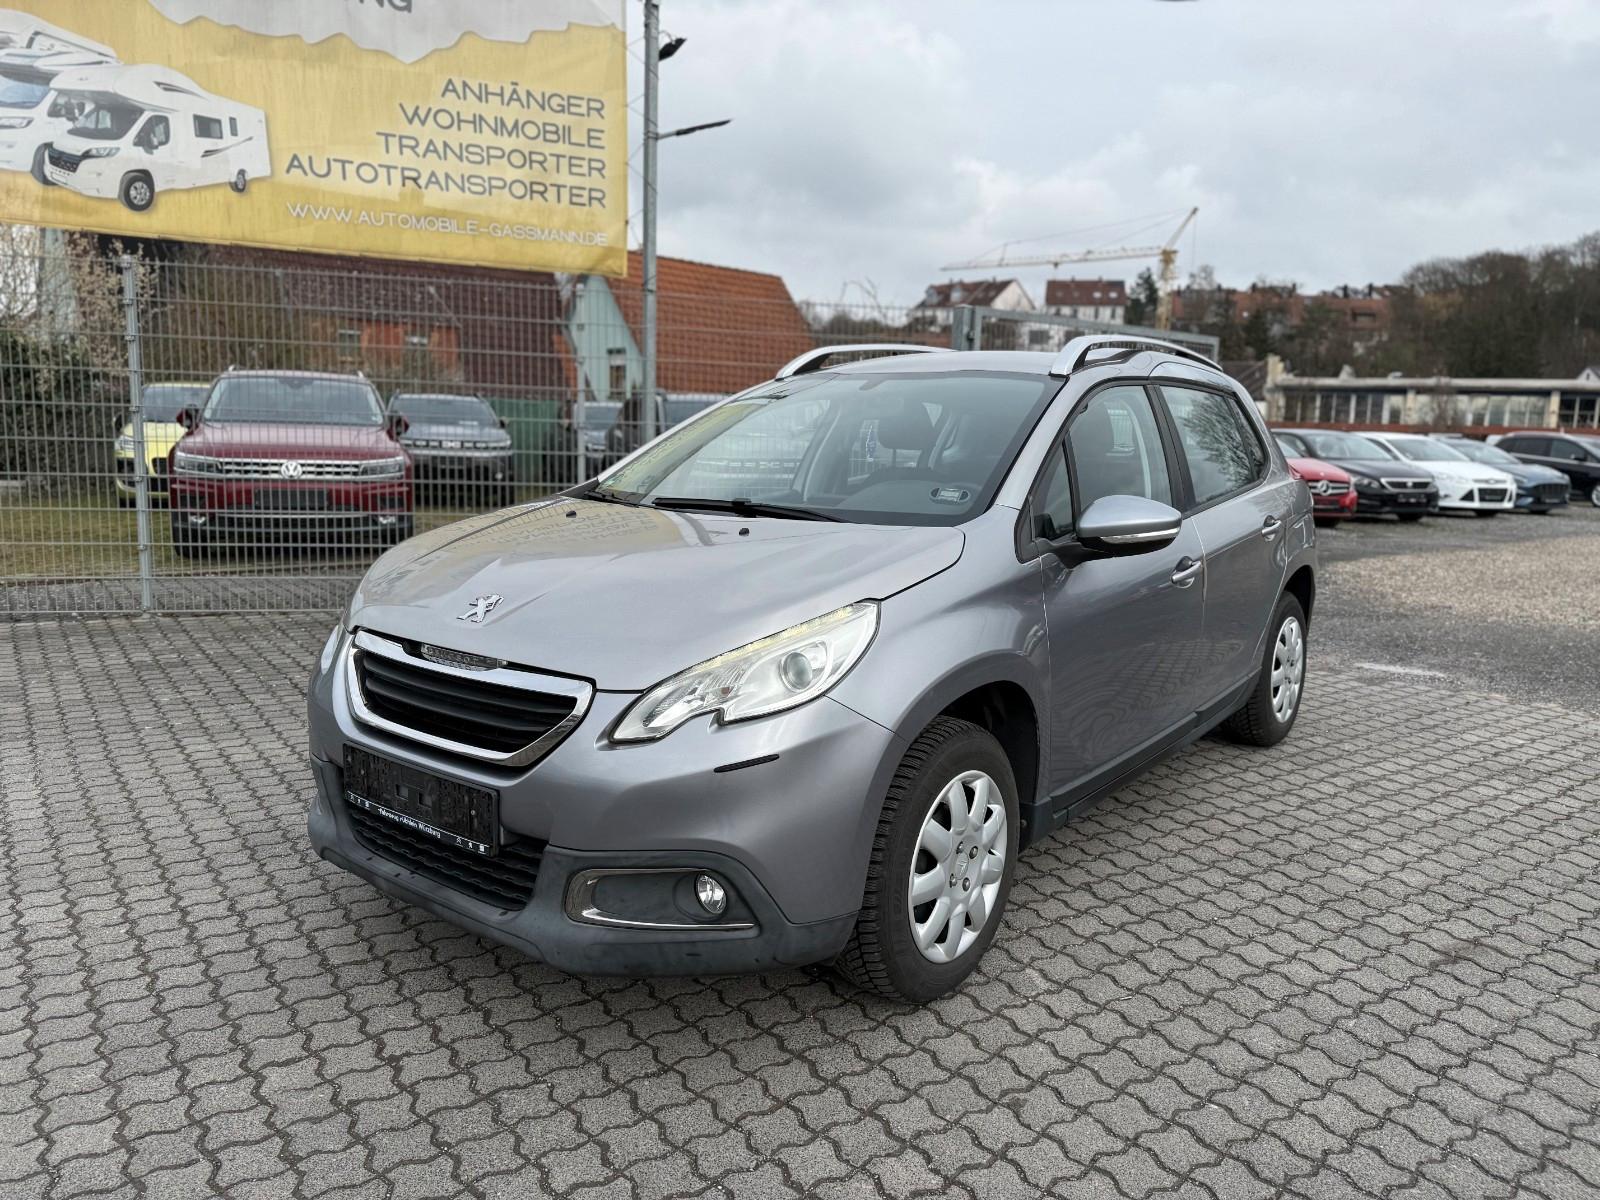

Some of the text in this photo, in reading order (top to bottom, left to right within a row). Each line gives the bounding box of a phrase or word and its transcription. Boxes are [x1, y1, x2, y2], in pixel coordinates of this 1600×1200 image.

[441, 78, 605, 119] ANHÄNGER
[399, 103, 605, 149] WOHNMOBILE
[376, 131, 606, 179] TRANSPORTER
[285, 153, 606, 208] AUTOTRANSPORTER
[287, 202, 608, 246] WWW.AUTOMOBILE-GASSMANN.DE
